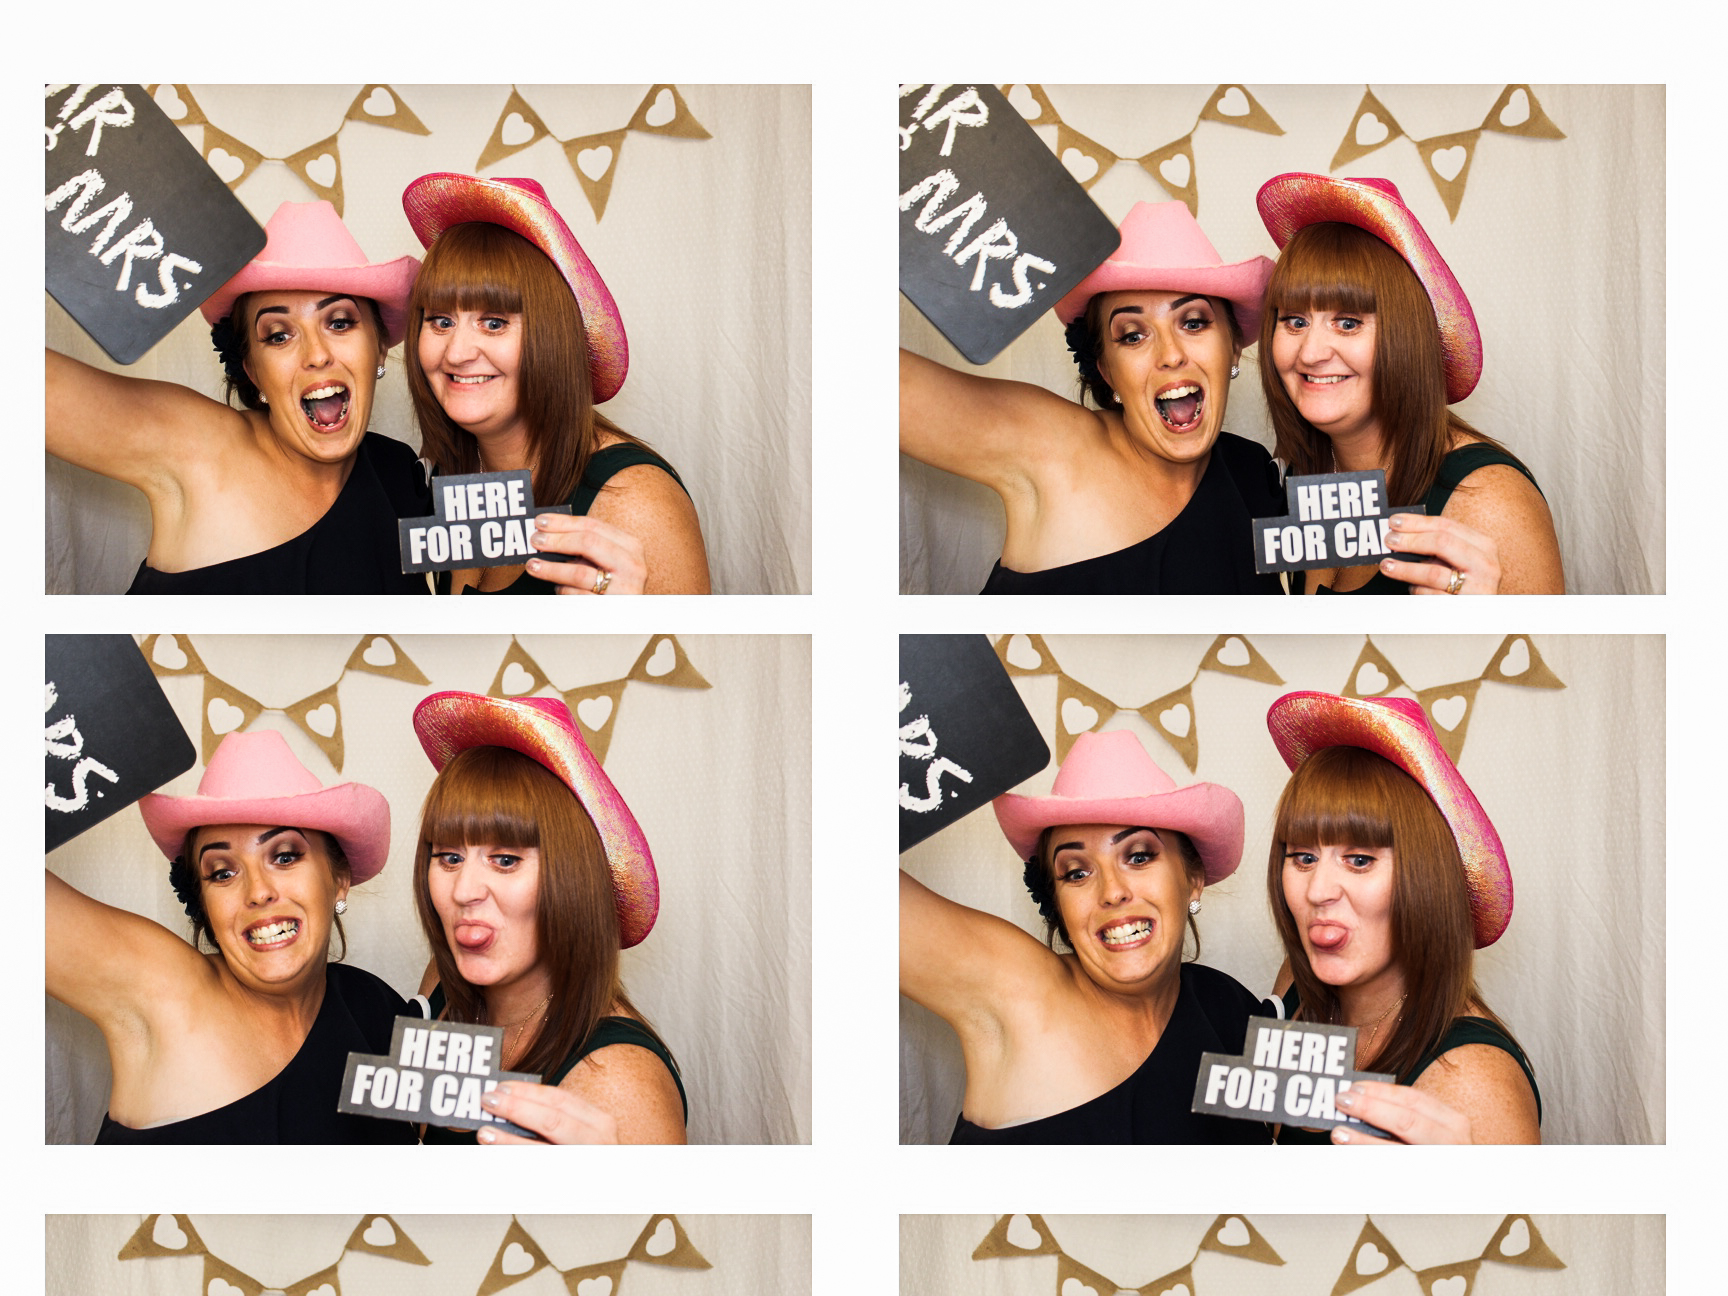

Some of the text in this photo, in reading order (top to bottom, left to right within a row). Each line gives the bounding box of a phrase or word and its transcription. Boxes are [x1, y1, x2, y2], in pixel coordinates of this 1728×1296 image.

[443, 480, 527, 522] HERE
[1297, 480, 1381, 522] HERE
[409, 524, 473, 565] FOR
[1263, 524, 1327, 565] FOR
[398, 1027, 494, 1076] HERE
[1252, 1027, 1348, 1076] HERE
[350, 1064, 425, 1113] FOR
[1204, 1064, 1279, 1113] FOR
